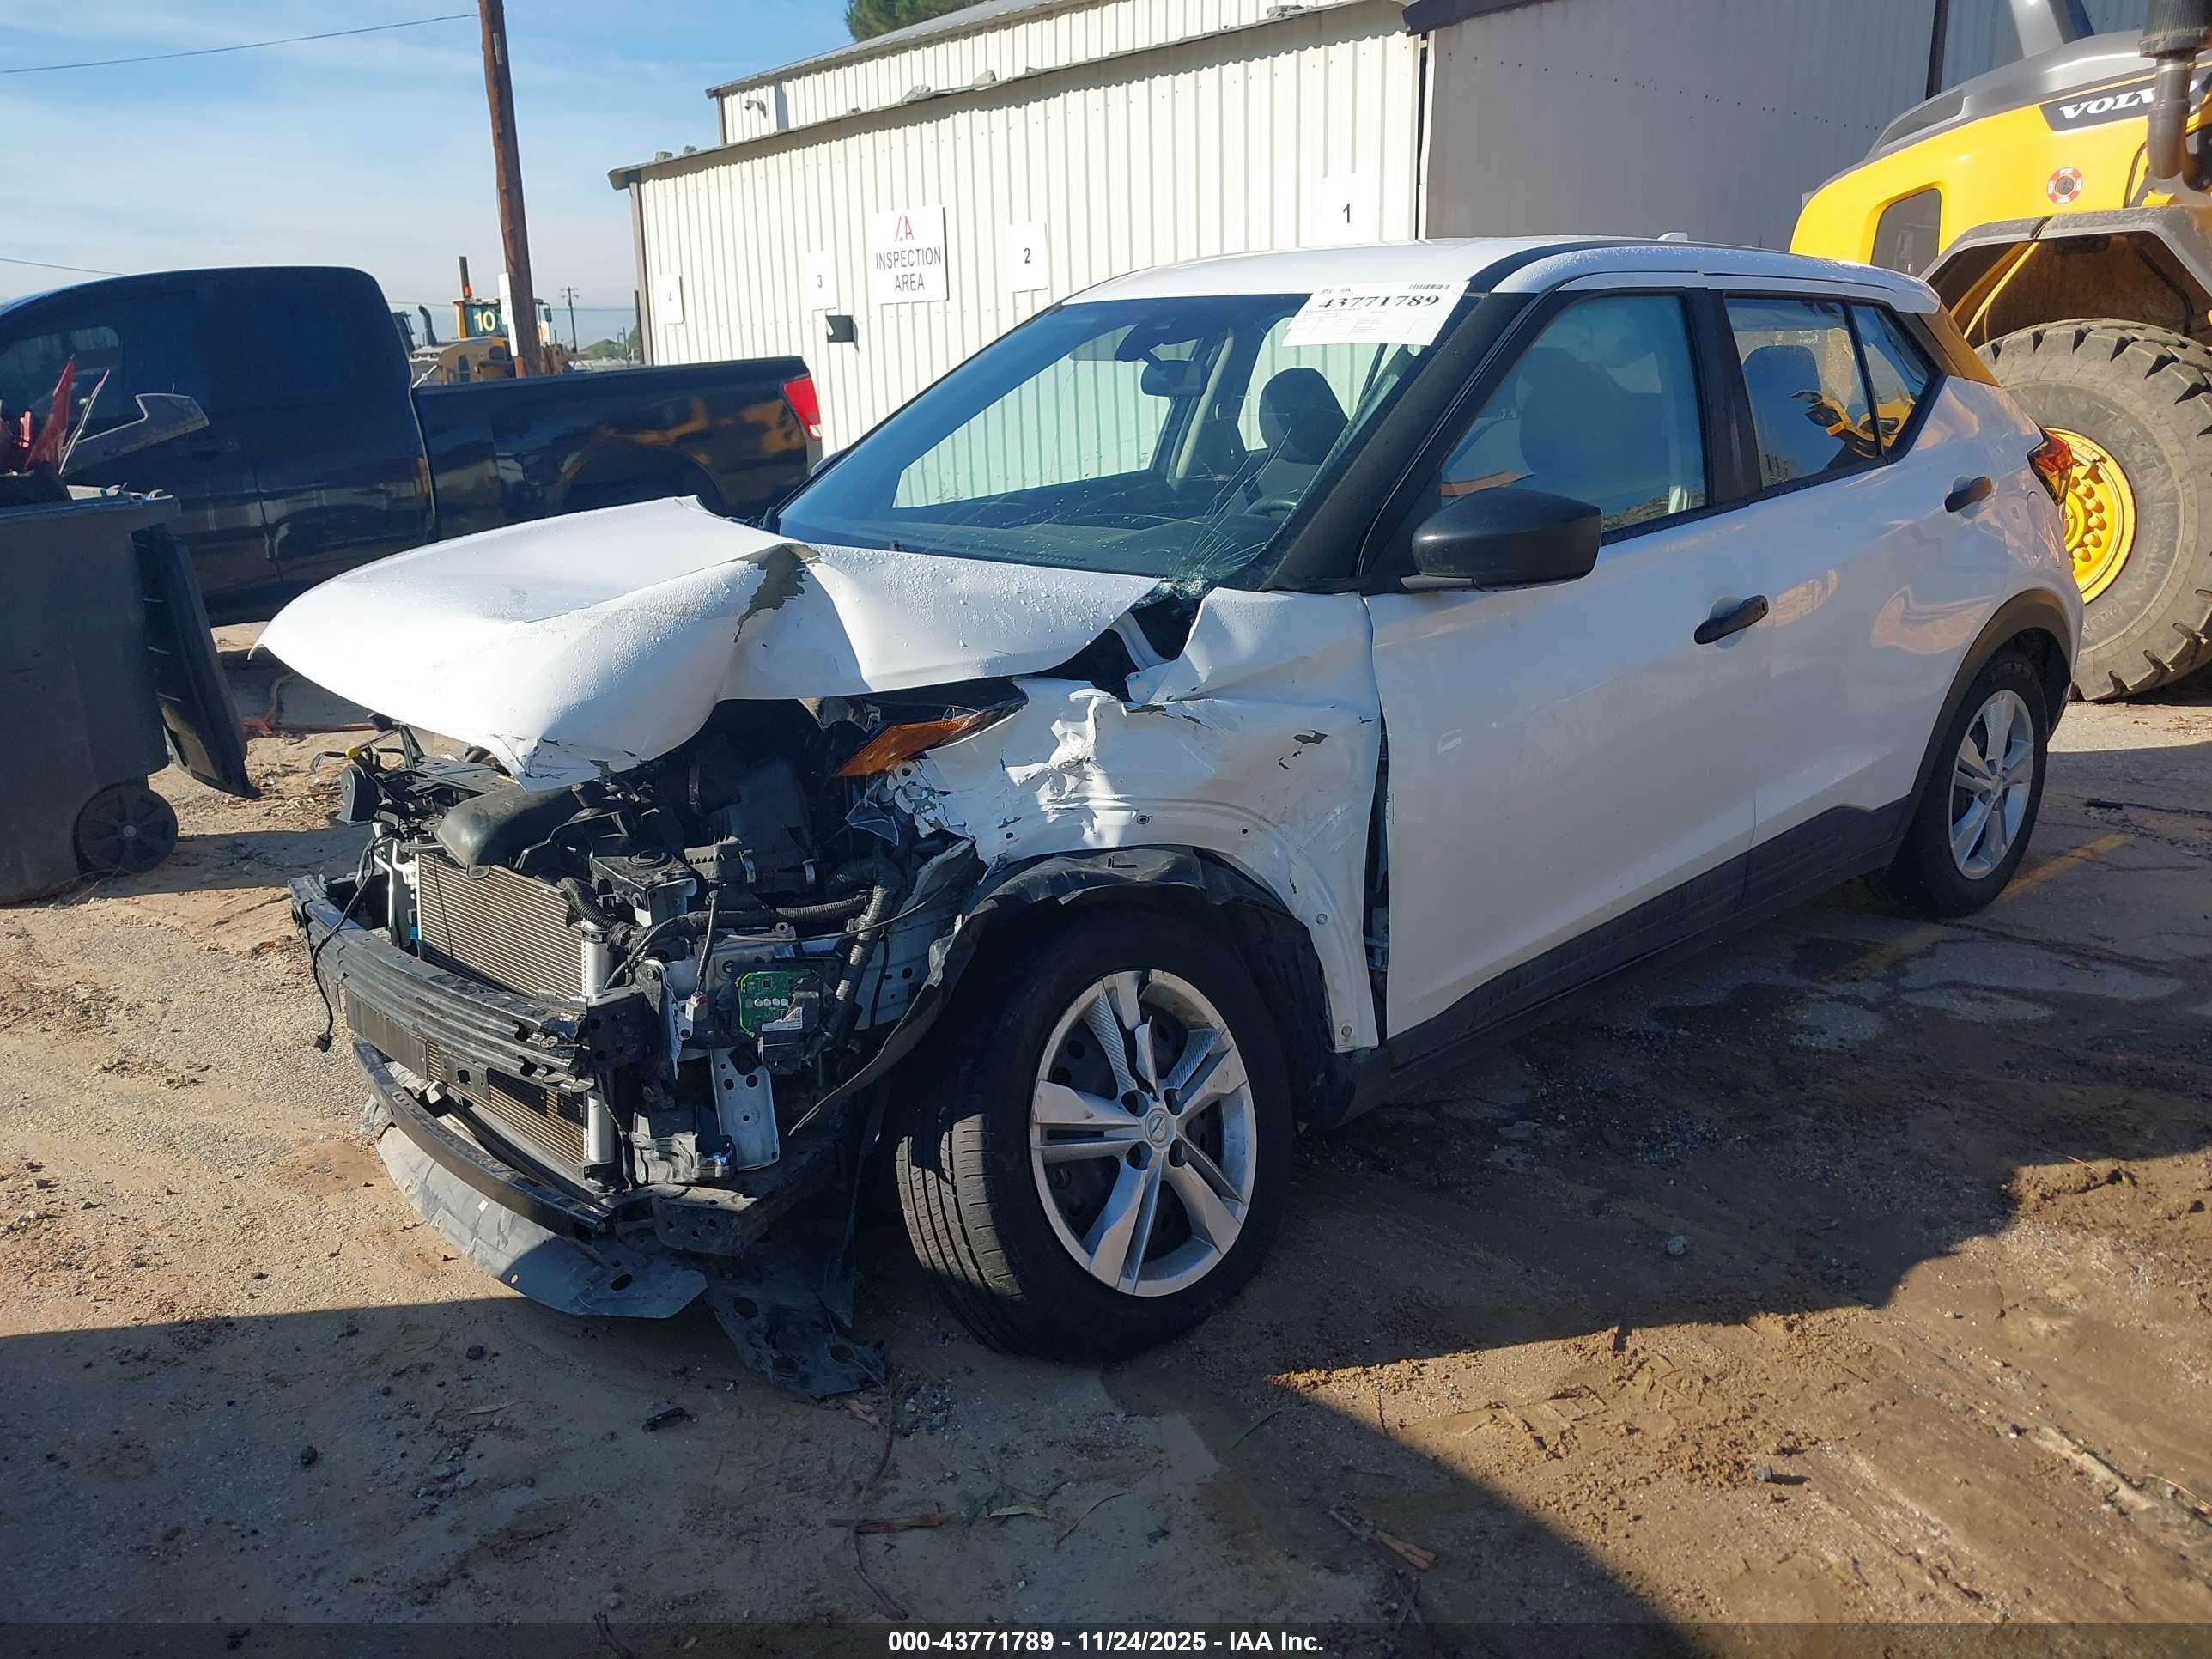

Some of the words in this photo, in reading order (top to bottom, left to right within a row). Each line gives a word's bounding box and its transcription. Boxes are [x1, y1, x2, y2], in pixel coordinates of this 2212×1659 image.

[2059, 80, 2198, 119] VOLV
[1342, 203, 1351, 224] 1
[876, 246, 942, 270] INSPECTION
[1023, 247, 1031, 264] 2
[817, 274, 823, 288] 3
[894, 273, 925, 293] AREA
[1318, 295, 1440, 309] 43771789
[473, 310, 496, 332] 10
